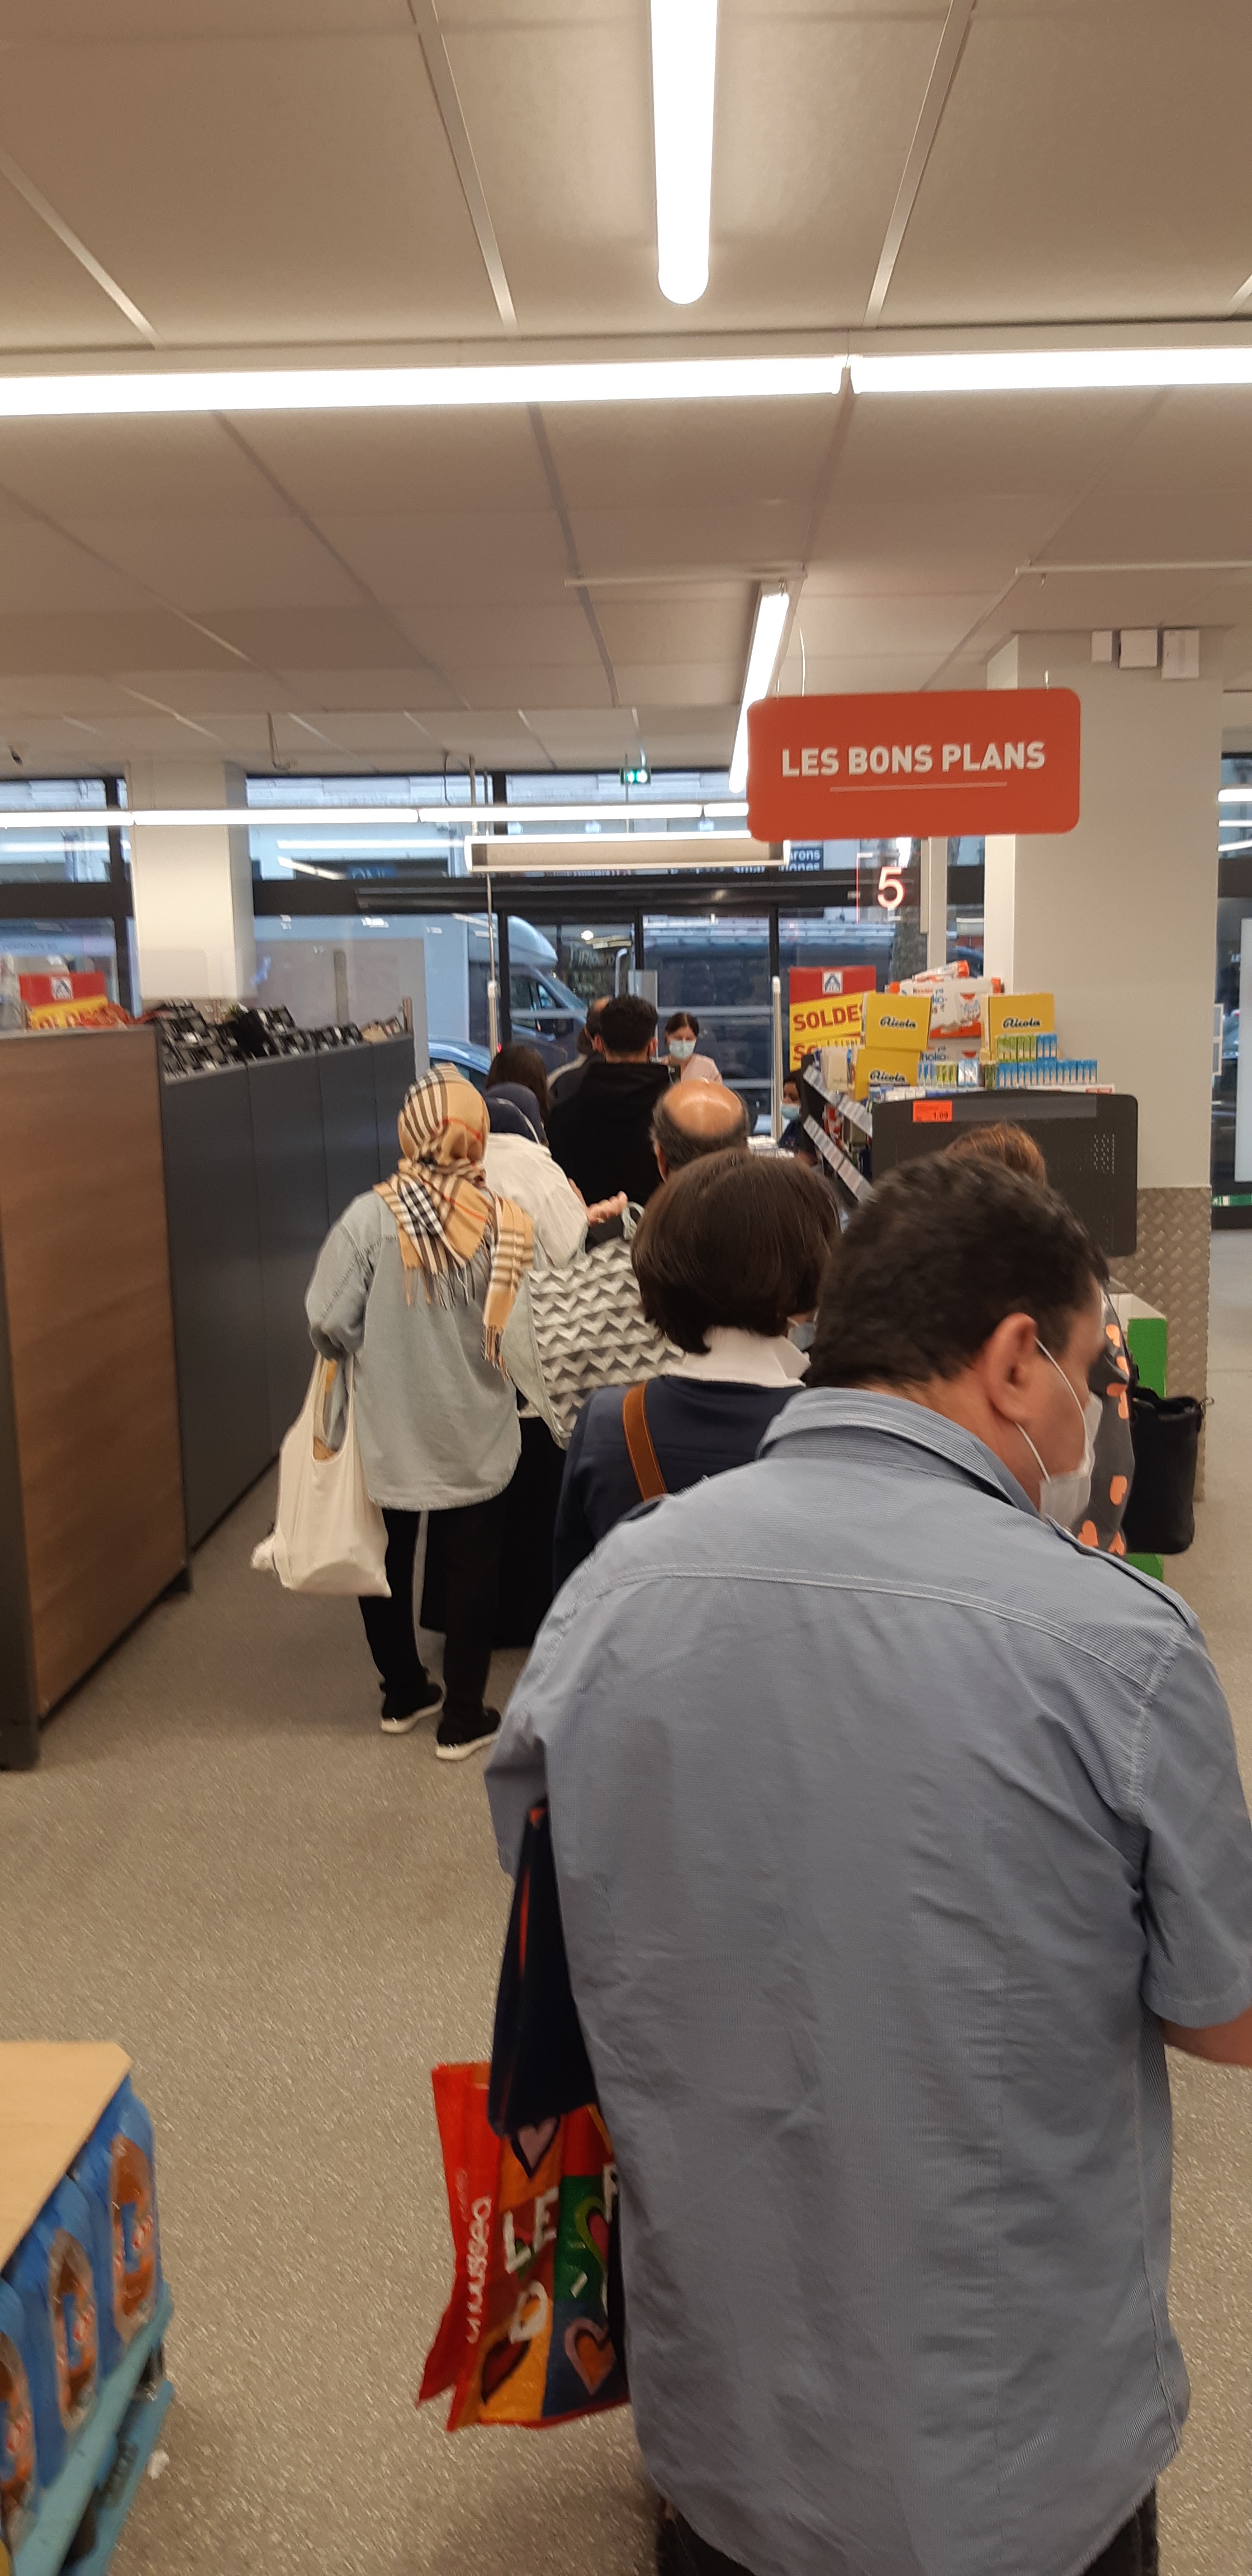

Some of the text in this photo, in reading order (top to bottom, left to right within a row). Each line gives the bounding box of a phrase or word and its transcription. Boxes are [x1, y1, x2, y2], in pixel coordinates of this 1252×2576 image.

[782, 741, 1045, 778] LES BONS PLANS
[877, 866, 904, 909] 5
[793, 1003, 863, 1032] SOLDE
[880, 1015, 917, 1029] Ricola
[1002, 1016, 1042, 1030] Ricola
[869, 1069, 906, 1083] Ricola
